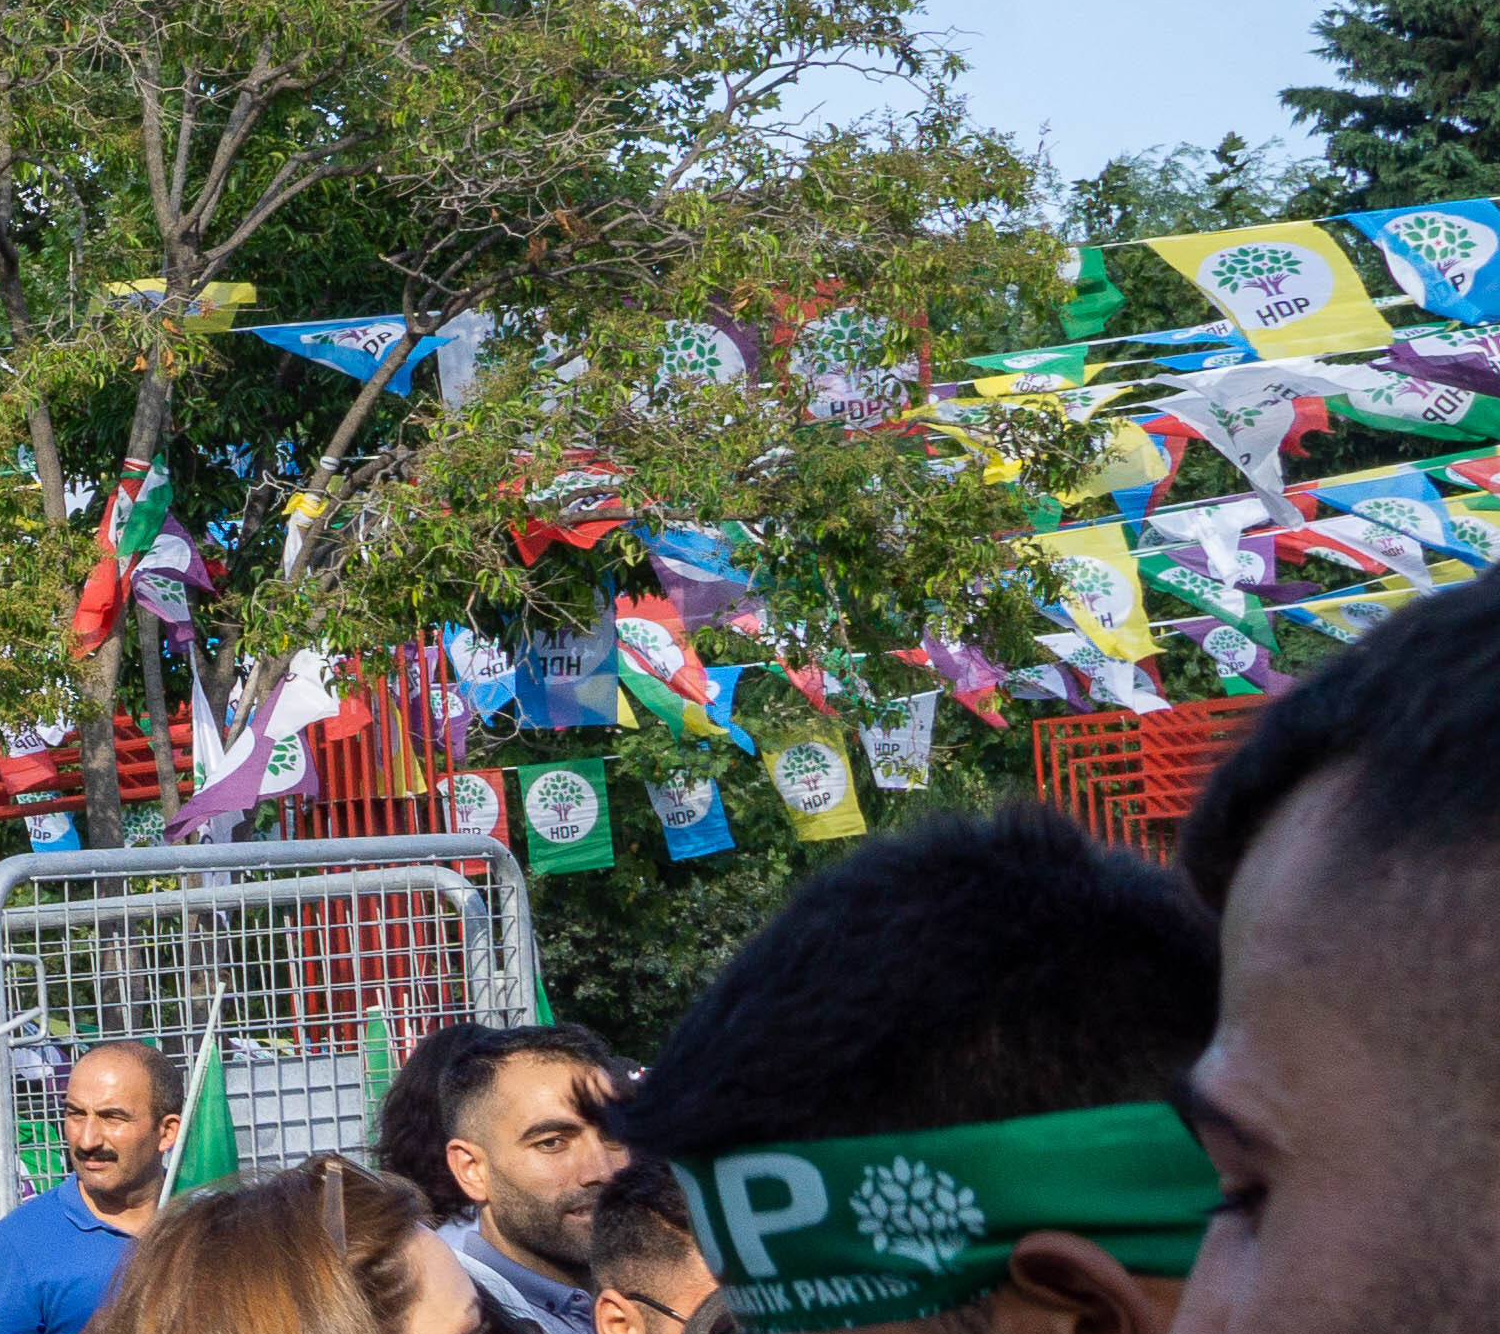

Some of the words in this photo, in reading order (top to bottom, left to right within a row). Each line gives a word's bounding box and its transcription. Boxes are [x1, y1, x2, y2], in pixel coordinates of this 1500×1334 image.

[1256, 297, 1310, 326] HDP
[363, 331, 393, 357] DP
[802, 792, 831, 811] HDP
[667, 810, 696, 826] HDP
[550, 825, 579, 840] HDP
